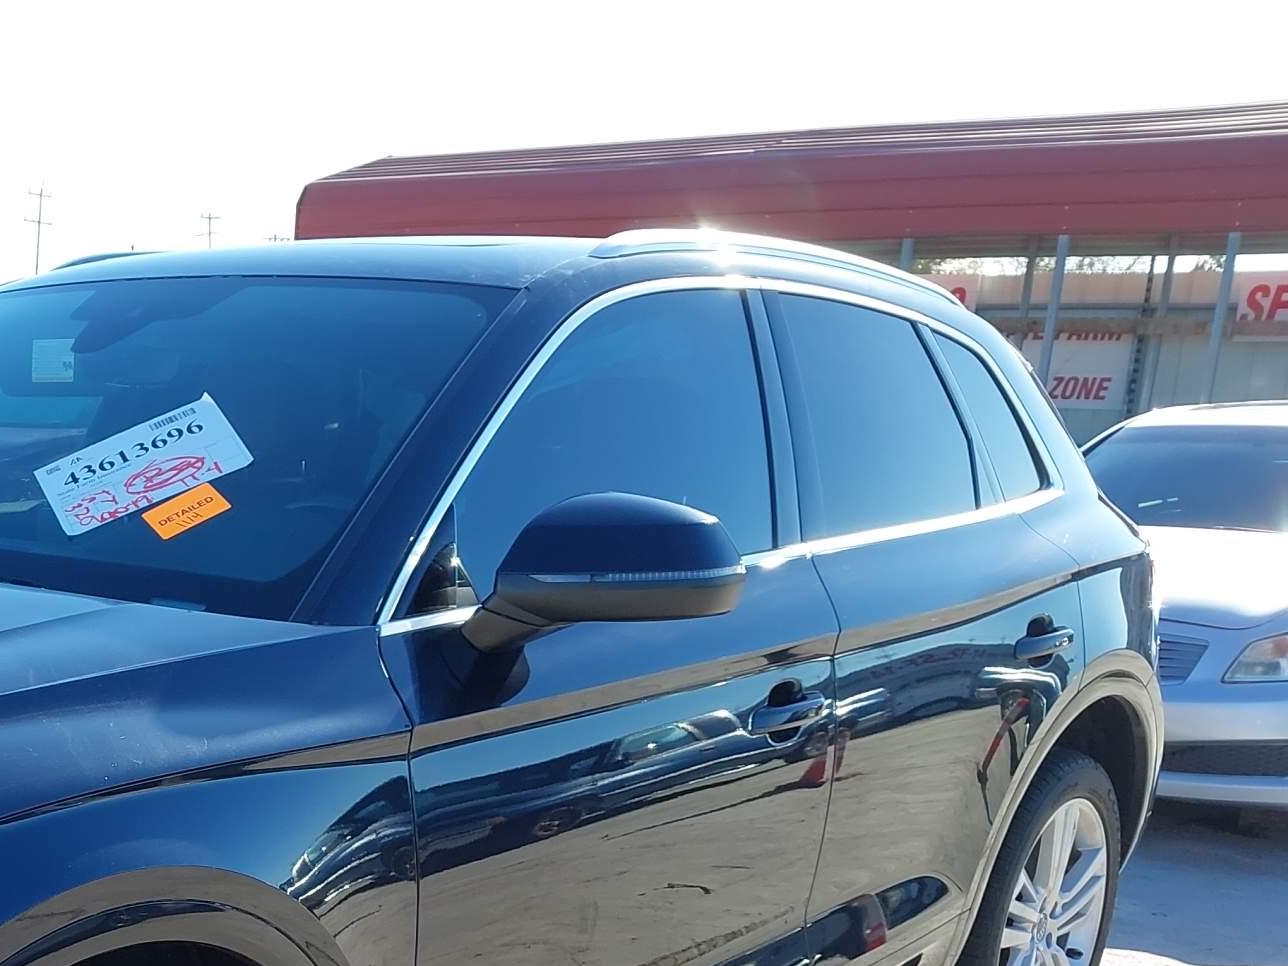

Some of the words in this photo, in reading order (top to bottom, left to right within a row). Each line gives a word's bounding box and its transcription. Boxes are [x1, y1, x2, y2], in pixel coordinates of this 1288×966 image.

[1049, 375, 1113, 401] ZONE
[63, 418, 205, 488] 43613696
[158, 495, 215, 527] DETAILED
